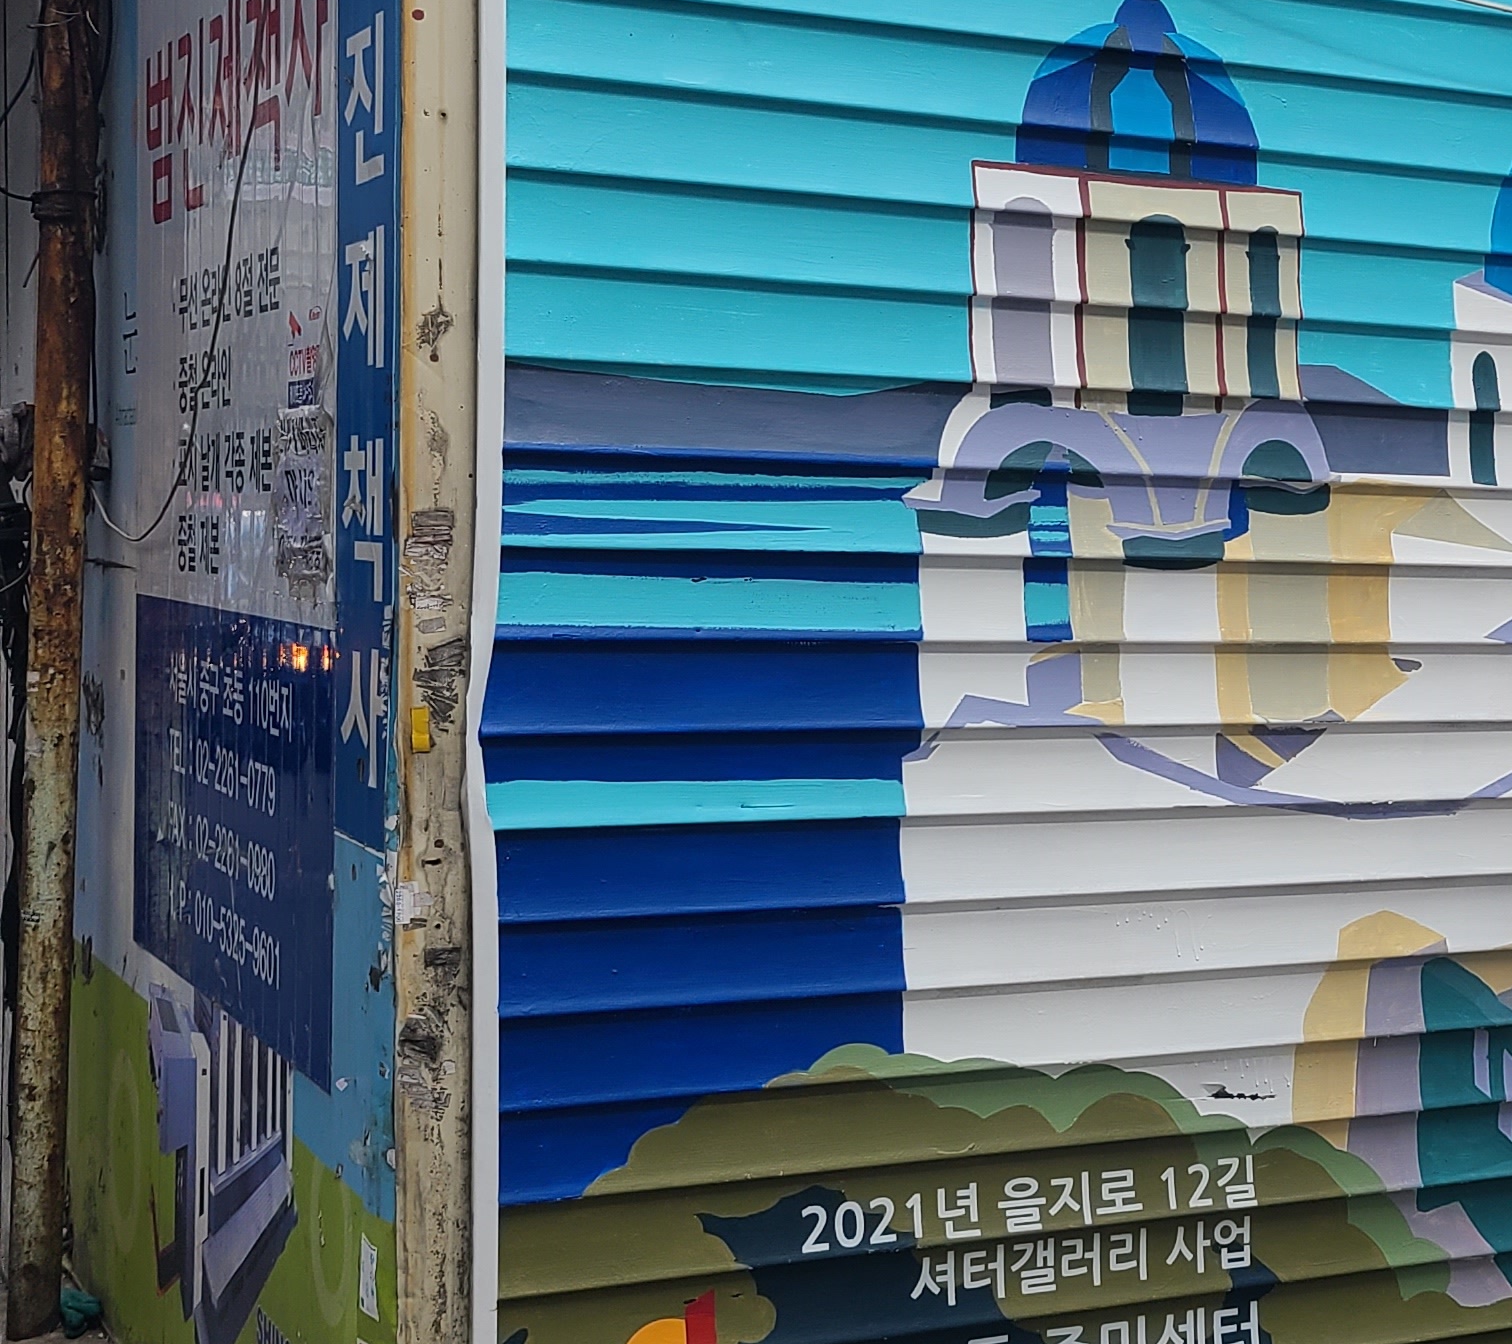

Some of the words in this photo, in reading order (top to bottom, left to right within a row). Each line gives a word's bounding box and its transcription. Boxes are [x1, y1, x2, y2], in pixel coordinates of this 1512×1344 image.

[179, 272, 198, 334] 무선
[258, 246, 280, 313] 전문
[225, 431, 246, 494] 각종
[250, 427, 273, 494] 제본
[178, 514, 197, 573] 중철
[200, 515, 220, 575] 제본
[200, 659, 220, 716] 중구
[800, 1182, 983, 1255] 2021년
[997, 1167, 1143, 1234] 을지로
[1159, 1154, 1259, 1212] 12길
[910, 1226, 1149, 1308] 셔터갤러리
[1165, 1215, 1254, 1277] 사업
